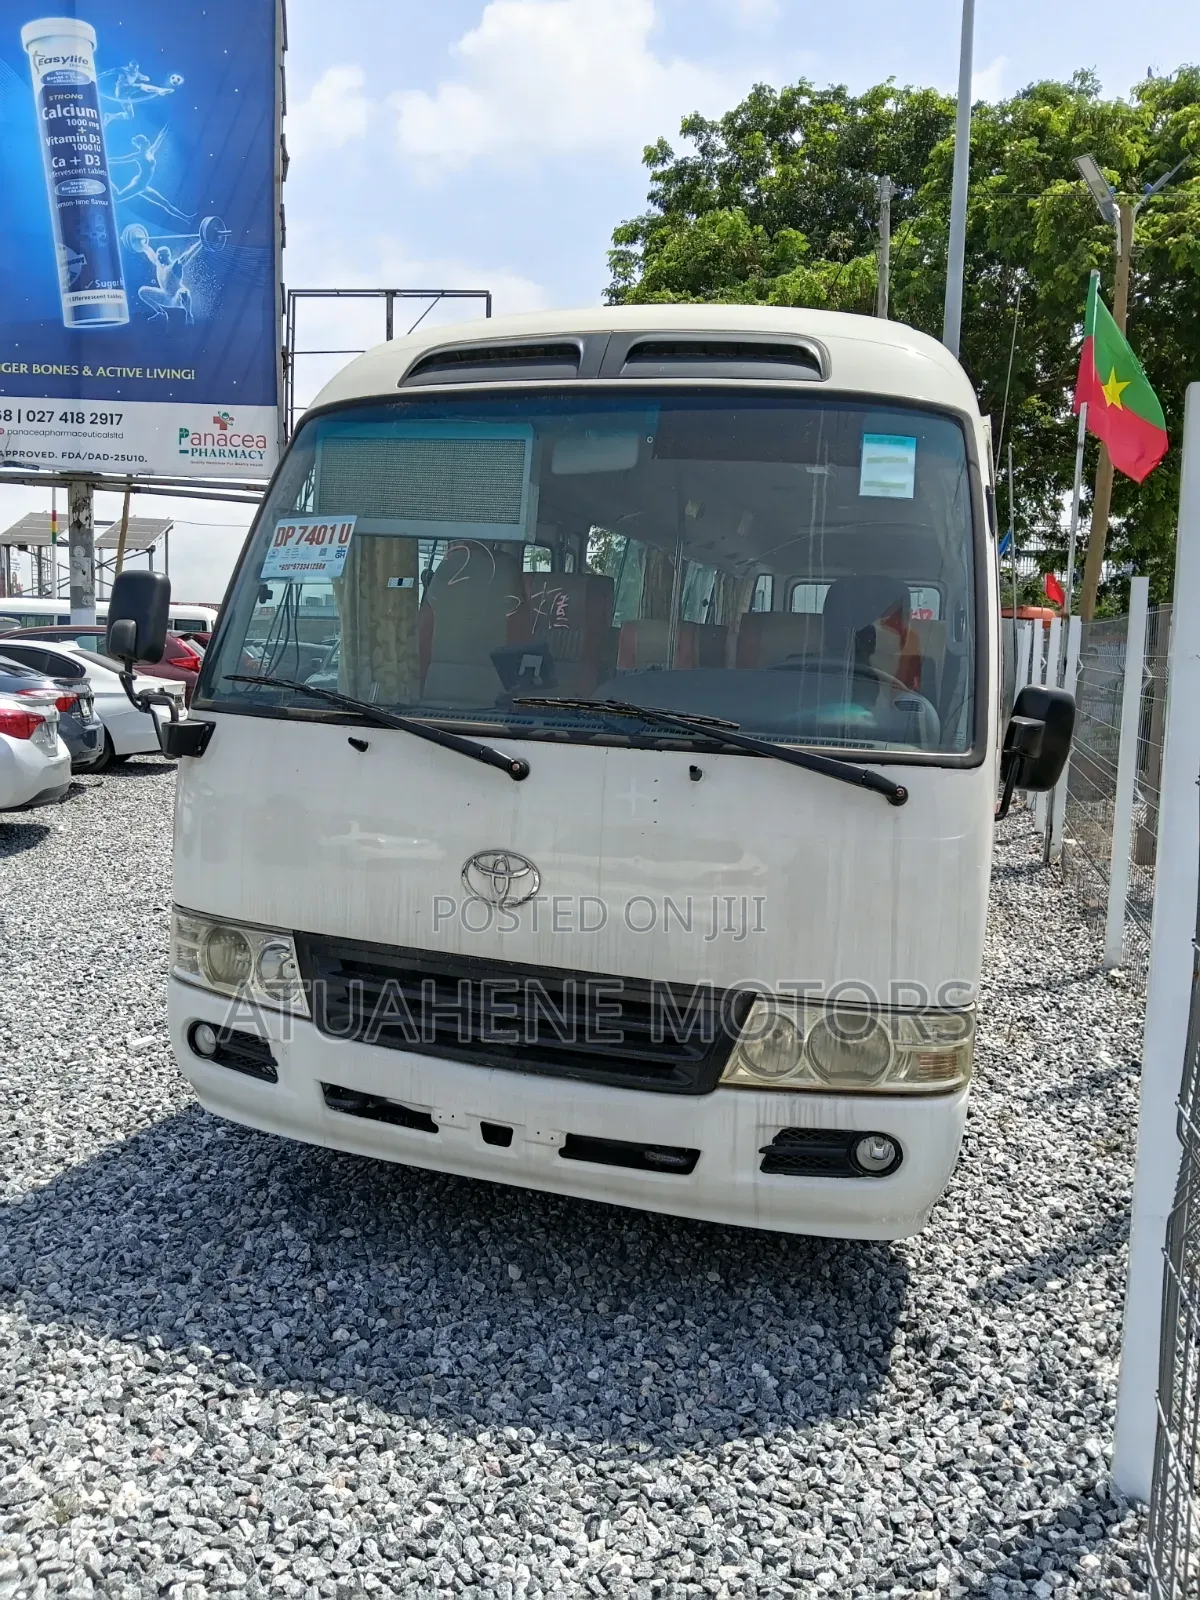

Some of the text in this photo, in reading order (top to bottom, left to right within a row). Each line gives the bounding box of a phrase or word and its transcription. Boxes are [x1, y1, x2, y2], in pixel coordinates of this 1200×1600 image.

[42, 103, 98, 120] Calcium
[66, 118, 100, 130] 1000 mg
[46, 133, 100, 146] Vitamin D3
[52, 154, 100, 168] Ca + D3
[95, 280, 119, 289] Sugar
[0, 363, 195, 380] GER BONES & ACTIVE LIVING!
[26, 410, 54, 423] 027
[59, 412, 85, 424] 418
[90, 412, 123, 426] 2917
[7, 429, 124, 439] panaceapharmaceuticalsltd
[179, 428, 266, 448] Panacea
[191, 448, 266, 460] PHARMACY
[274, 524, 352, 547] DP 7401 U
